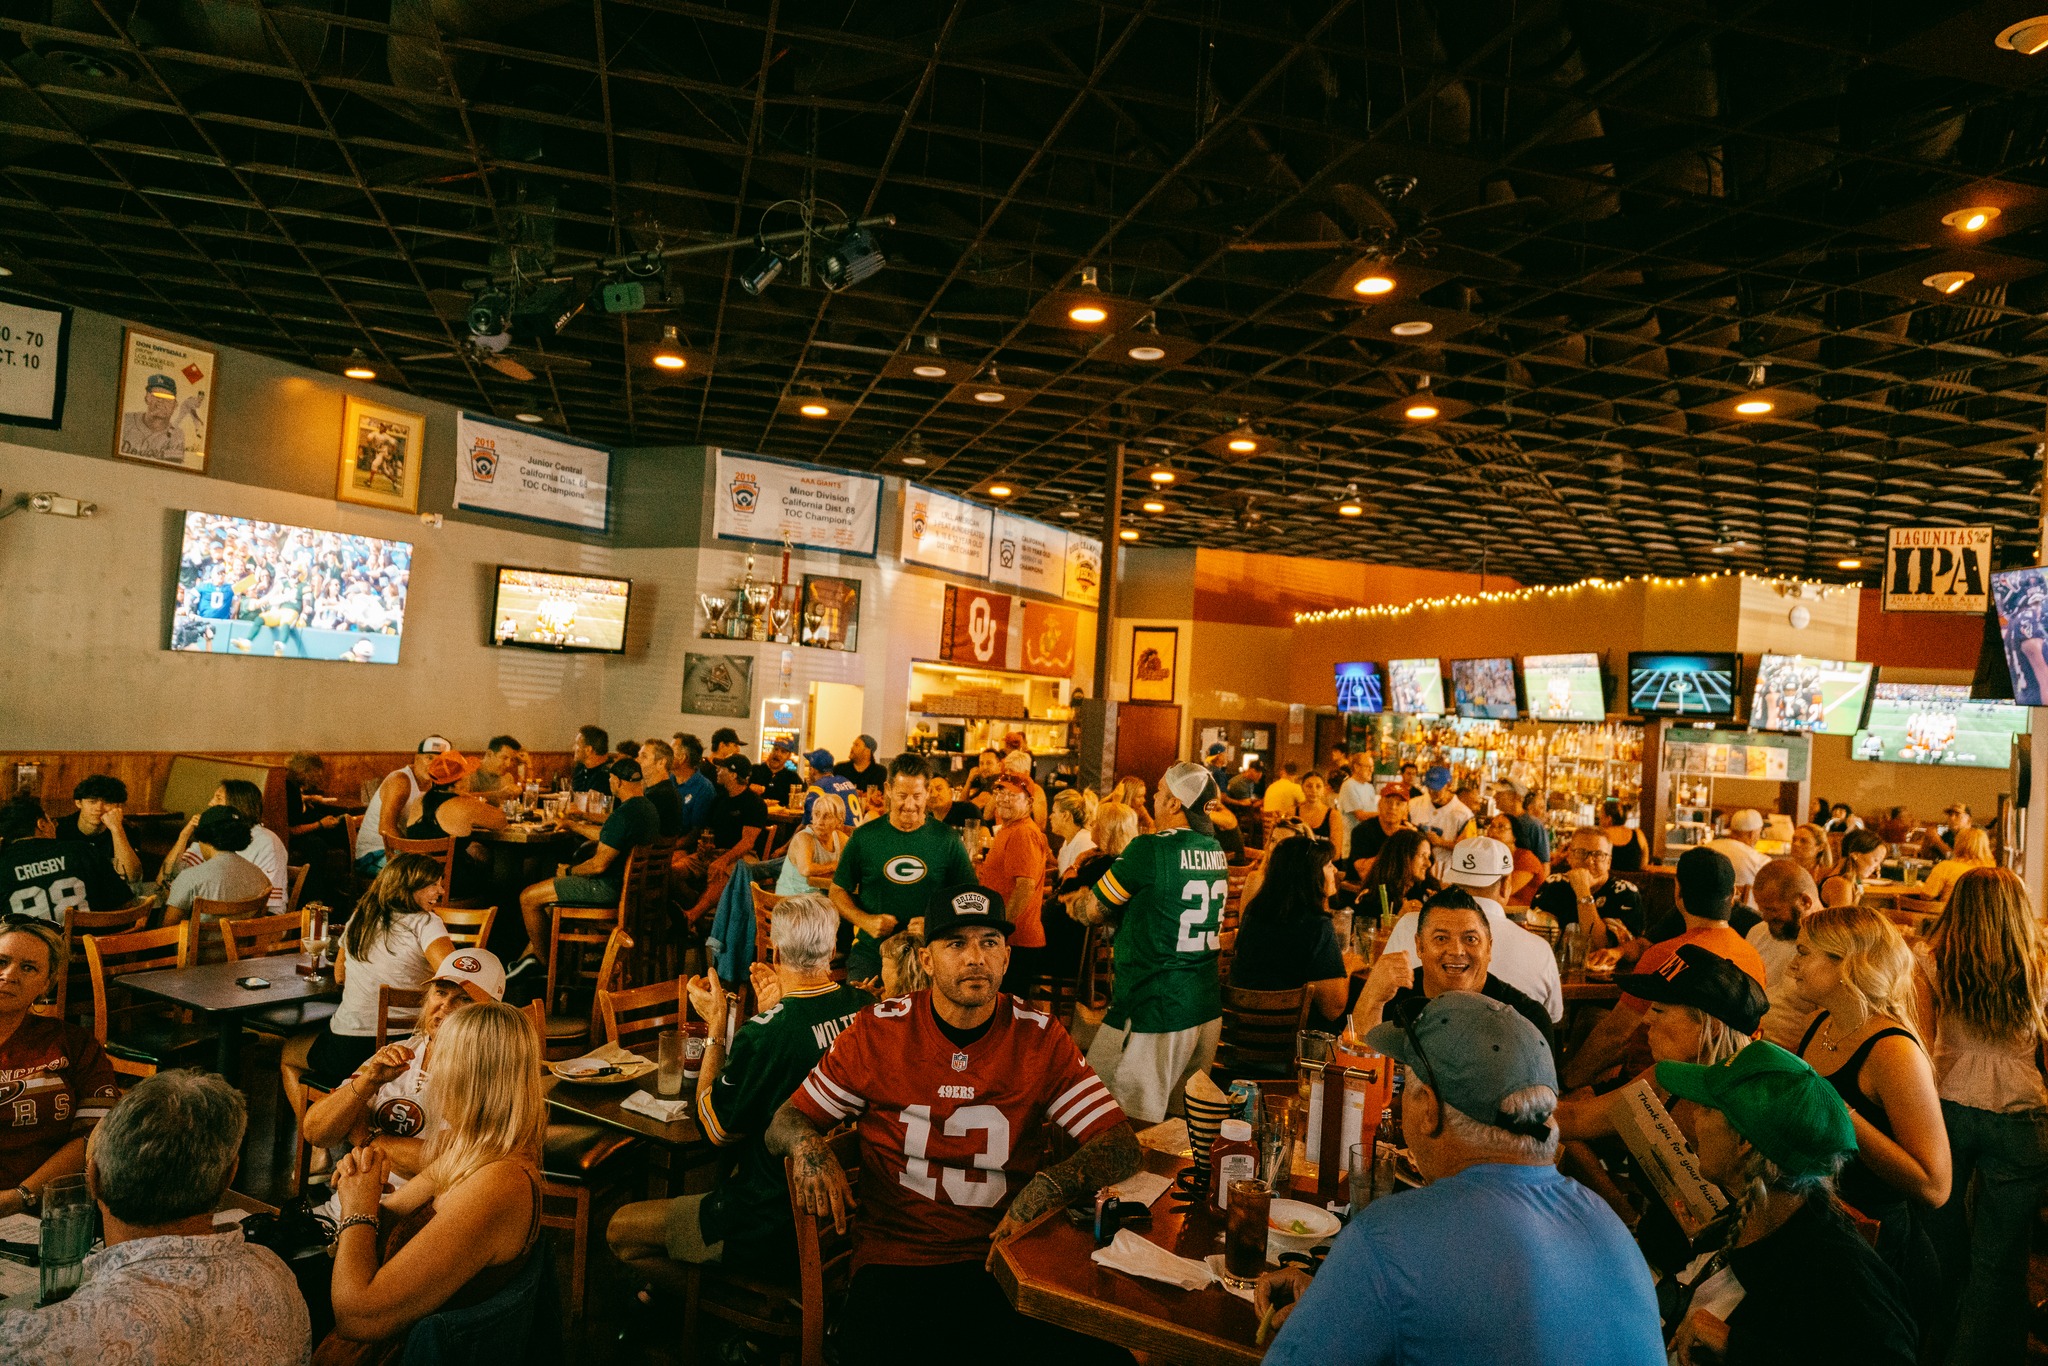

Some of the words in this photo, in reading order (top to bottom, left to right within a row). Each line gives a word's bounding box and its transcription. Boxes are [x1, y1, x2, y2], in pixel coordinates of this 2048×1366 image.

[0, 326, 10, 341] 0
[26, 331, 43, 347] 70
[23, 353, 40, 369] 10
[475, 437, 495, 449] 2019
[528, 456, 554, 469] Junior
[555, 462, 583, 475] Central
[520, 467, 558, 482] California
[560, 475, 576, 486] Dist.
[735, 471, 756, 482] 2019
[801, 477, 815, 485] AAA
[522, 479, 540, 491] TOC
[541, 482, 585, 499] Champions
[790, 486, 814, 497] Minor
[816, 490, 849, 503] Division
[782, 496, 823, 509] California
[825, 503, 843, 514] Dist.
[845, 506, 856, 515] 68
[784, 508, 803, 518] TOC
[805, 511, 852, 526] Champions
[1895, 530, 1974, 546] LAGUNITAS
[1889, 547, 1985, 595] IPA
[14, 856, 65, 881] CROSBY
[956, 894, 986, 905] BRIXTON
[1176, 880, 1228, 952] 23
[937, 1085, 975, 1099] 49ERS
[1638, 1091, 1660, 1121] Thank
[1656, 1123, 1672, 1141] you
[1670, 1141, 1684, 1157] for
[1680, 1160, 1701, 1182] your
[899, 1104, 1010, 1208] 13
